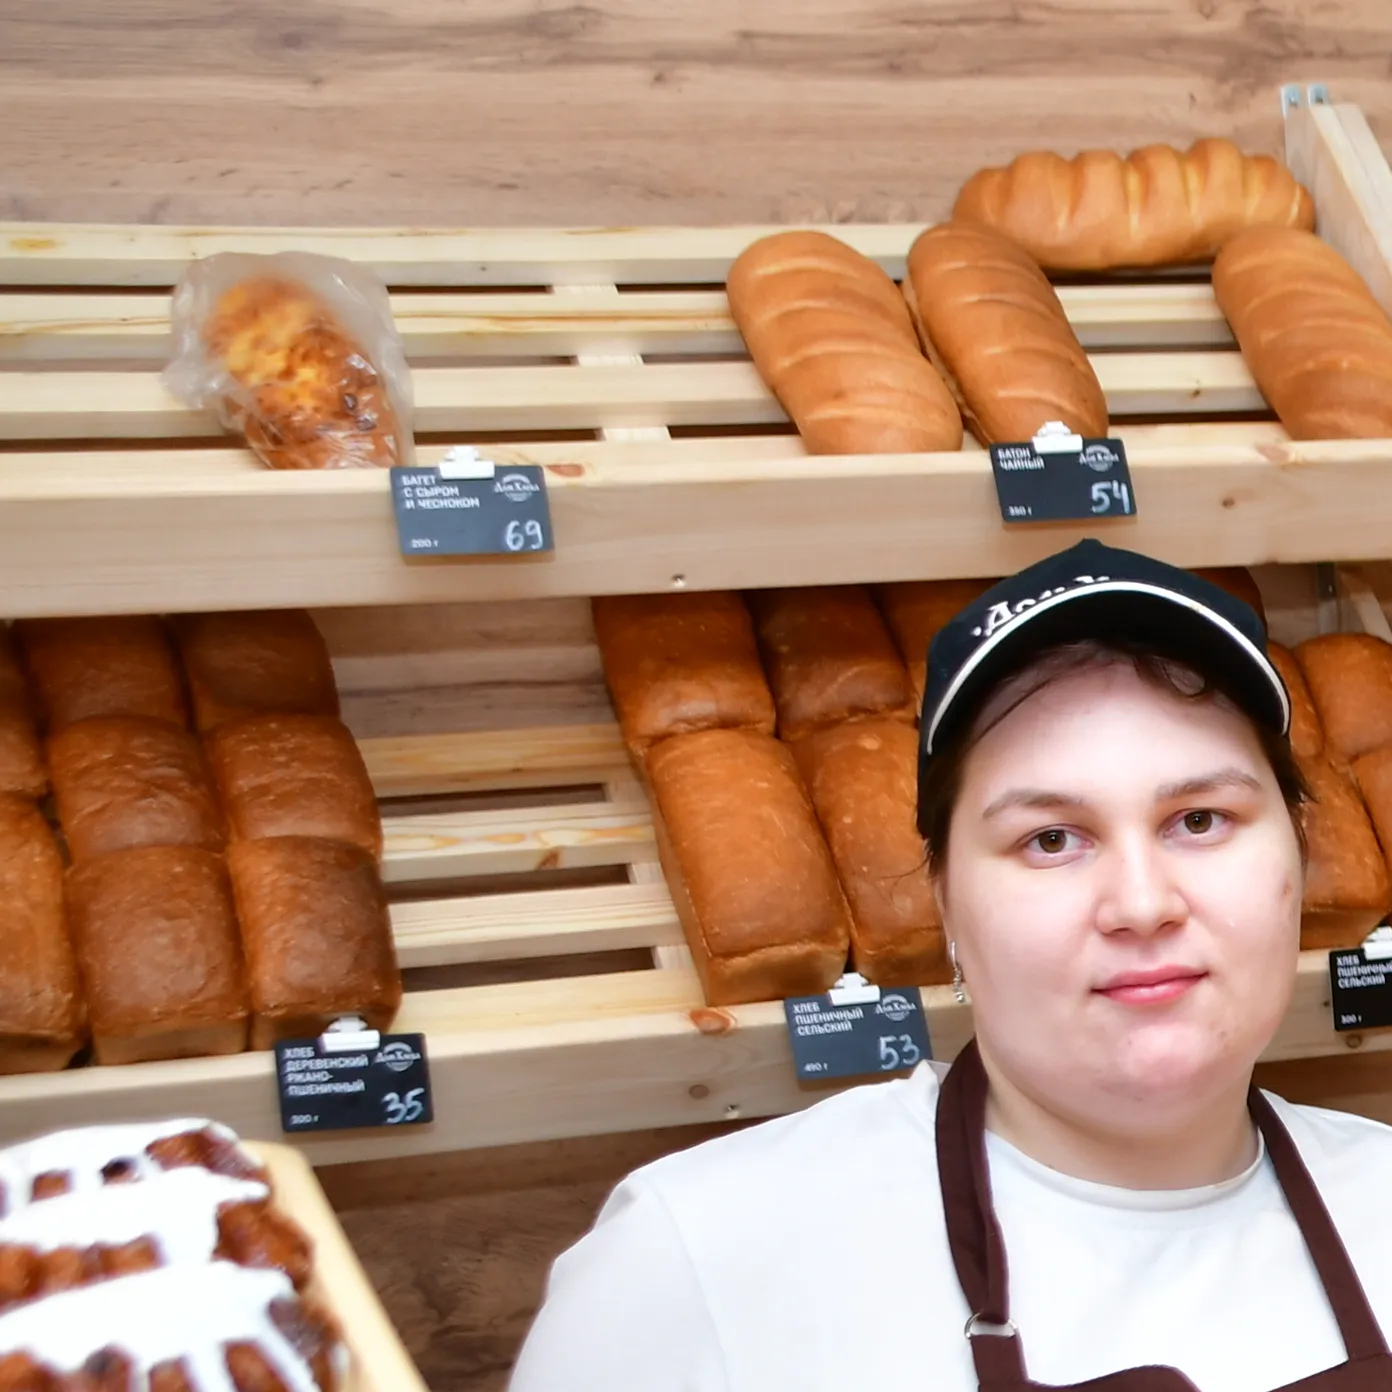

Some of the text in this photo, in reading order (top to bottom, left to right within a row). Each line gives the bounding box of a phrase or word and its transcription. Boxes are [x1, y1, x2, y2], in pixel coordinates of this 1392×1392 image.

[998, 448, 1030, 459] БАТОН
[402, 475, 435, 486] БАГЕТ
[404, 486, 459, 497] С СЫРОМ
[1091, 480, 1130, 514] 54
[406, 497, 480, 509] И ЧЕСНОКОМ
[505, 520, 543, 550] 69
[1336, 954, 1360, 966] ХЛЕБ
[1338, 973, 1386, 989] СЕЛЬСКИЙ
[793, 1002, 820, 1013] ХЛЕБ
[795, 1007, 864, 1025] ПШЕНИЧНЫЙ
[797, 1021, 853, 1036] СЕЛЬСКИЙ
[284, 1047, 315, 1058] ХЛЕБ
[879, 1034, 920, 1070] 53
[285, 1055, 369, 1072] ДЕРЕВЕНСКИЙ
[287, 1071, 334, 1082] РЖАНО-
[287, 1079, 365, 1096] ПШЕНИЧНЫЙ
[382, 1087, 424, 1124] 35
